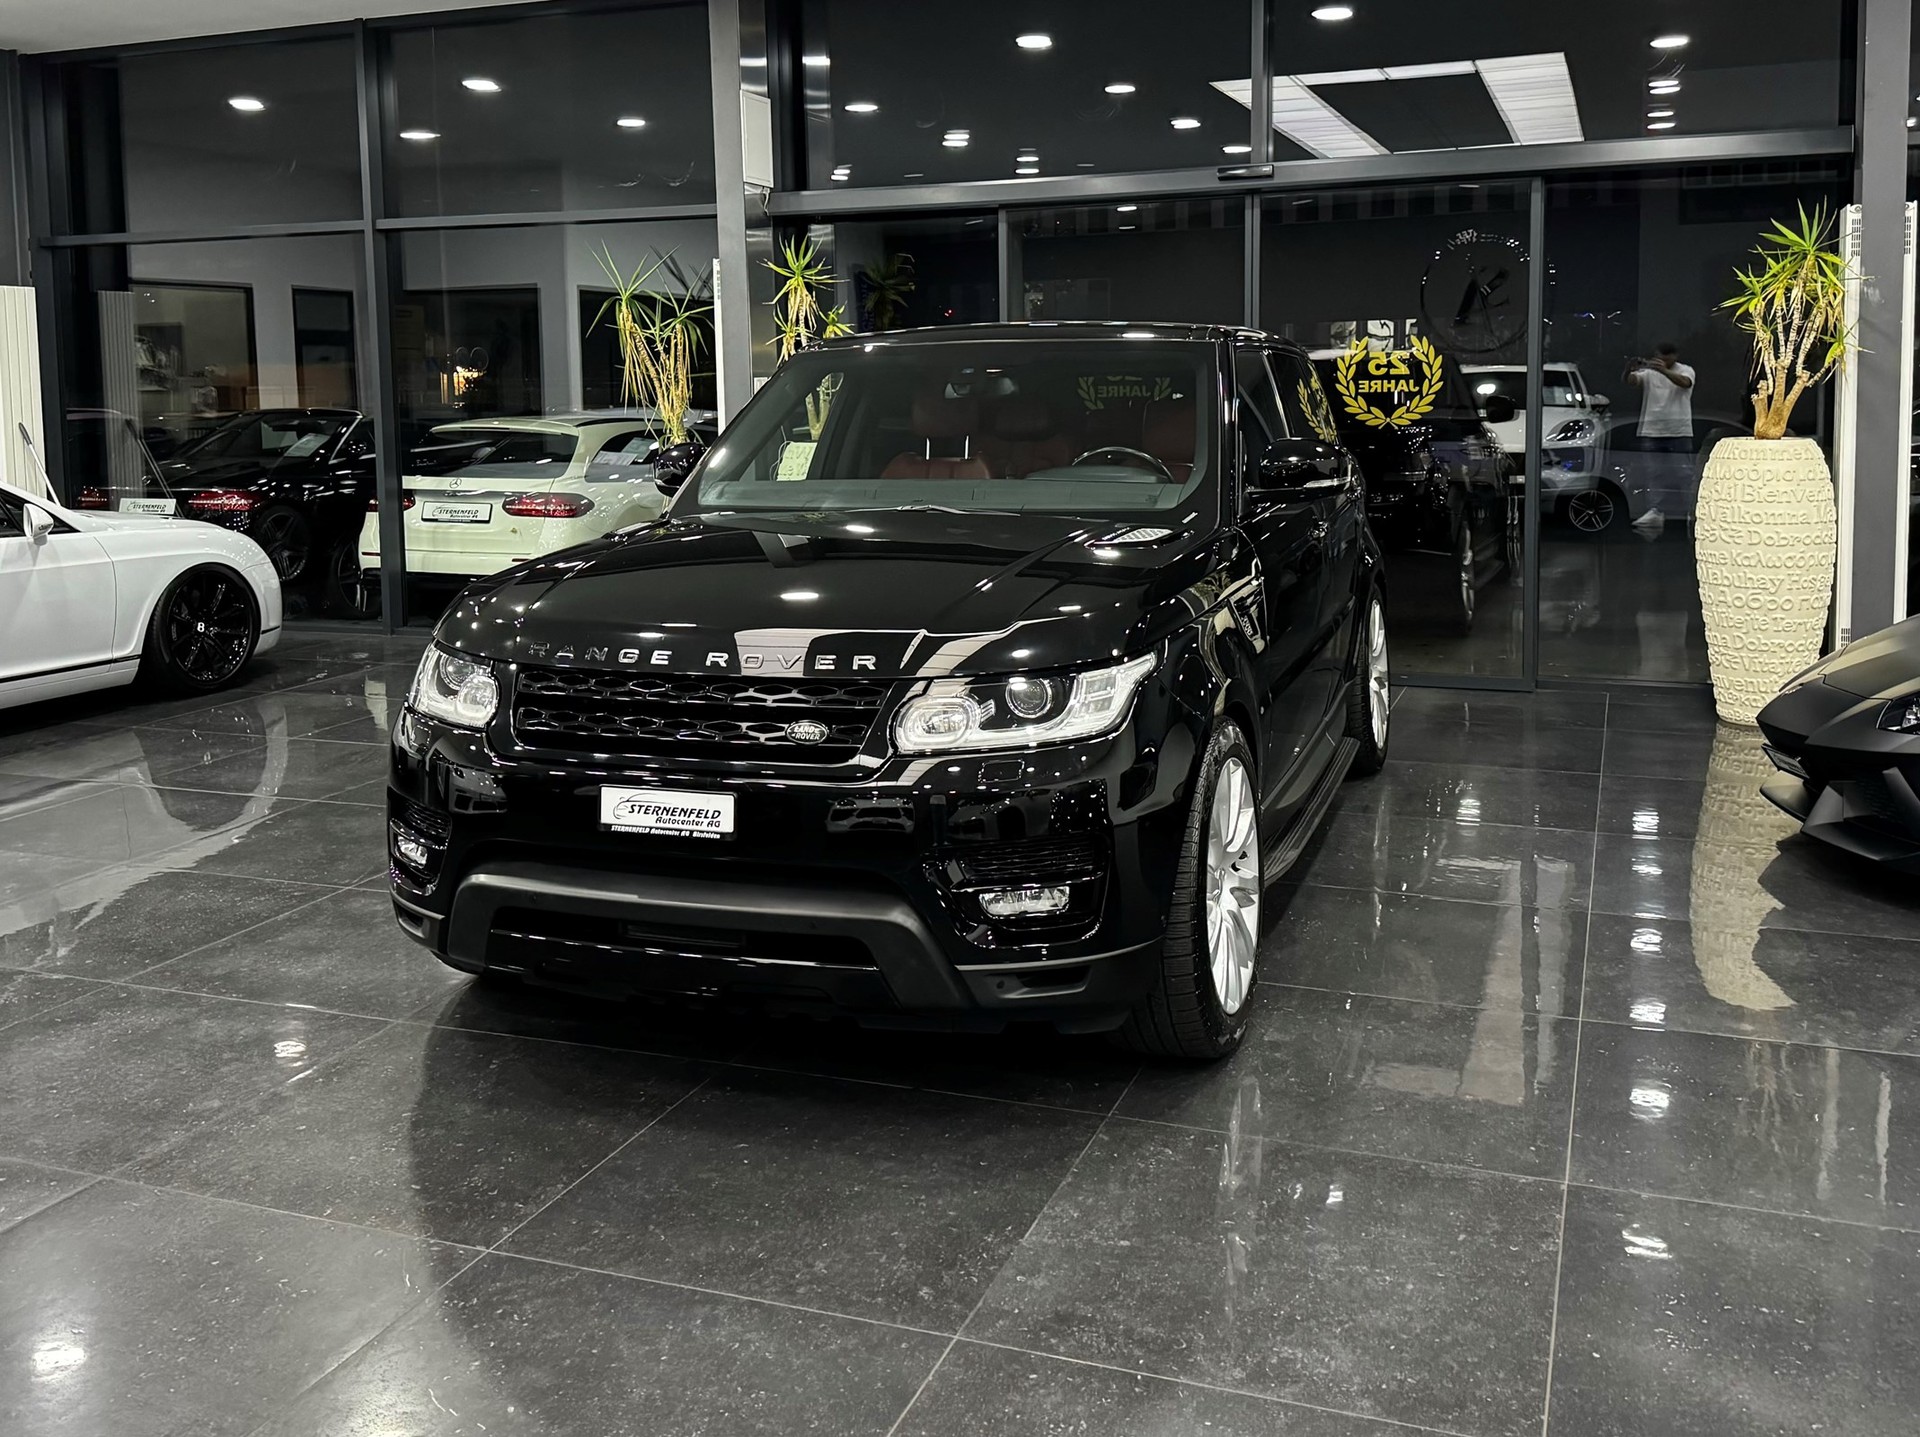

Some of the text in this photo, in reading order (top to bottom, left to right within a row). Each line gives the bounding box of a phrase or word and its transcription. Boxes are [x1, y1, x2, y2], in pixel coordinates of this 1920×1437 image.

[528, 641, 876, 670] RANGE ROVER
[795, 732, 820, 740] ROVER
[628, 804, 721, 819] STERNENFELD
[655, 816, 721, 828] Autocenter AG
